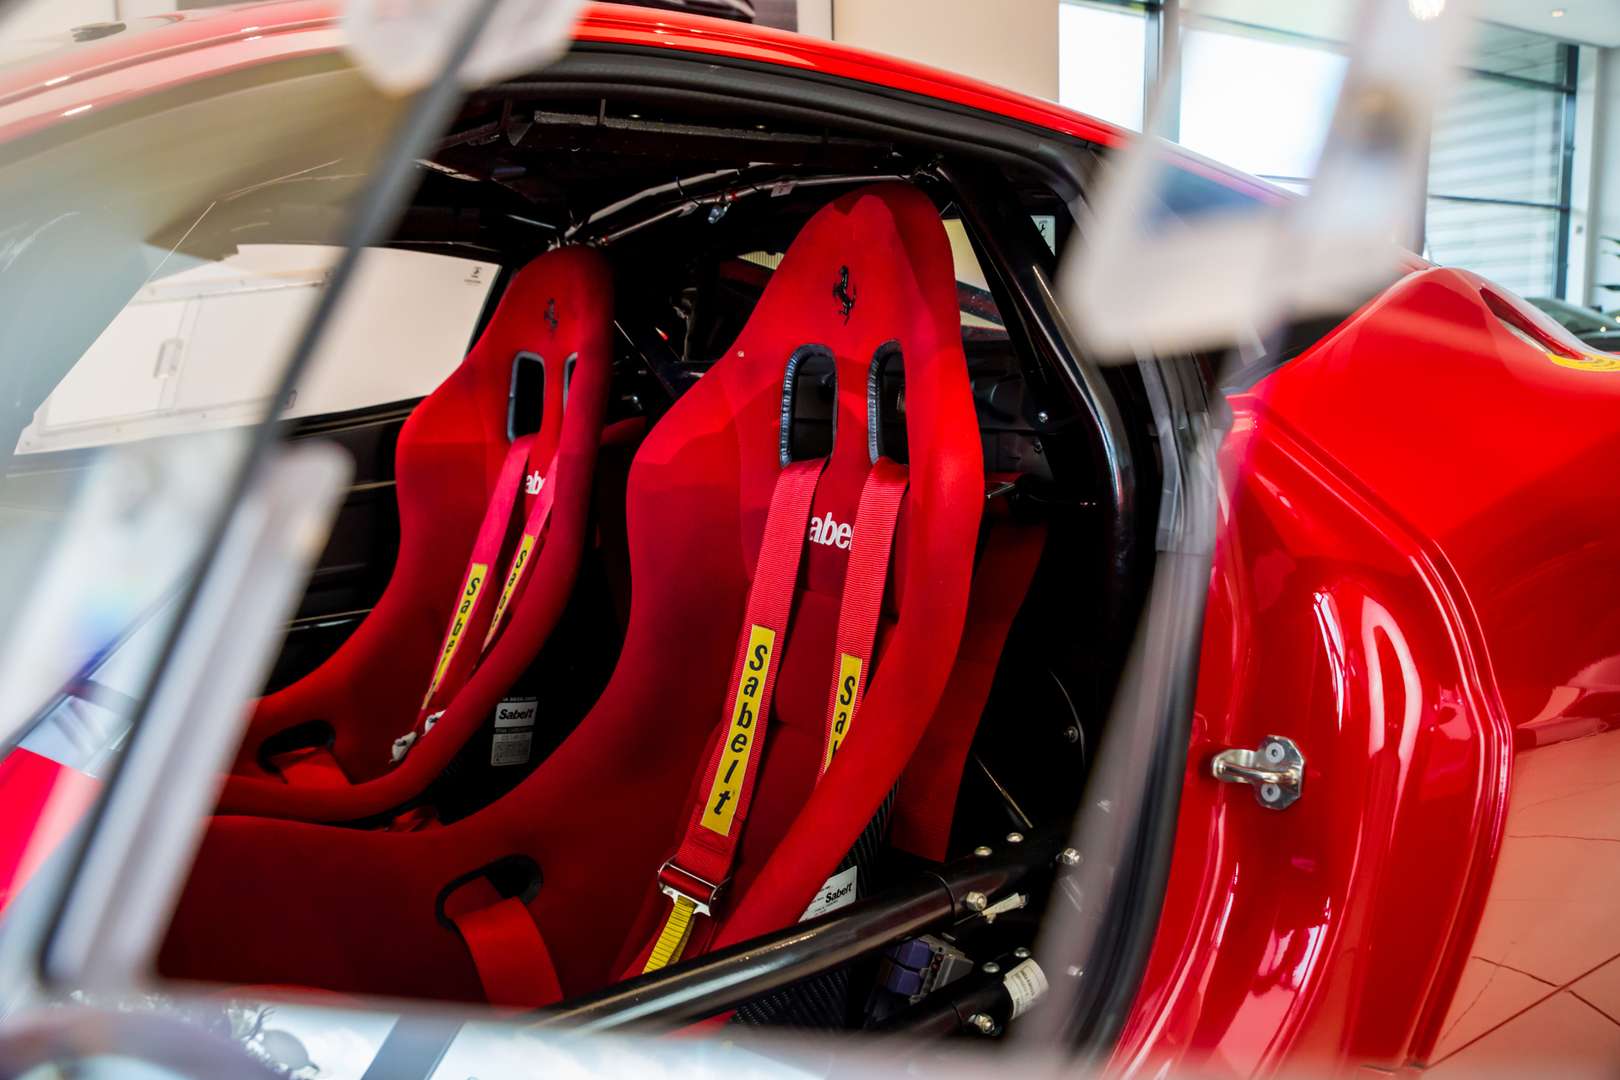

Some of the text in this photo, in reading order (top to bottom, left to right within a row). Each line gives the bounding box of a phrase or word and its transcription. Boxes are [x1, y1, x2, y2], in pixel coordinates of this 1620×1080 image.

[498, 708, 534, 720] Sabelt
[713, 644, 768, 816] Sabelt
[825, 882, 853, 904] Sabelt
